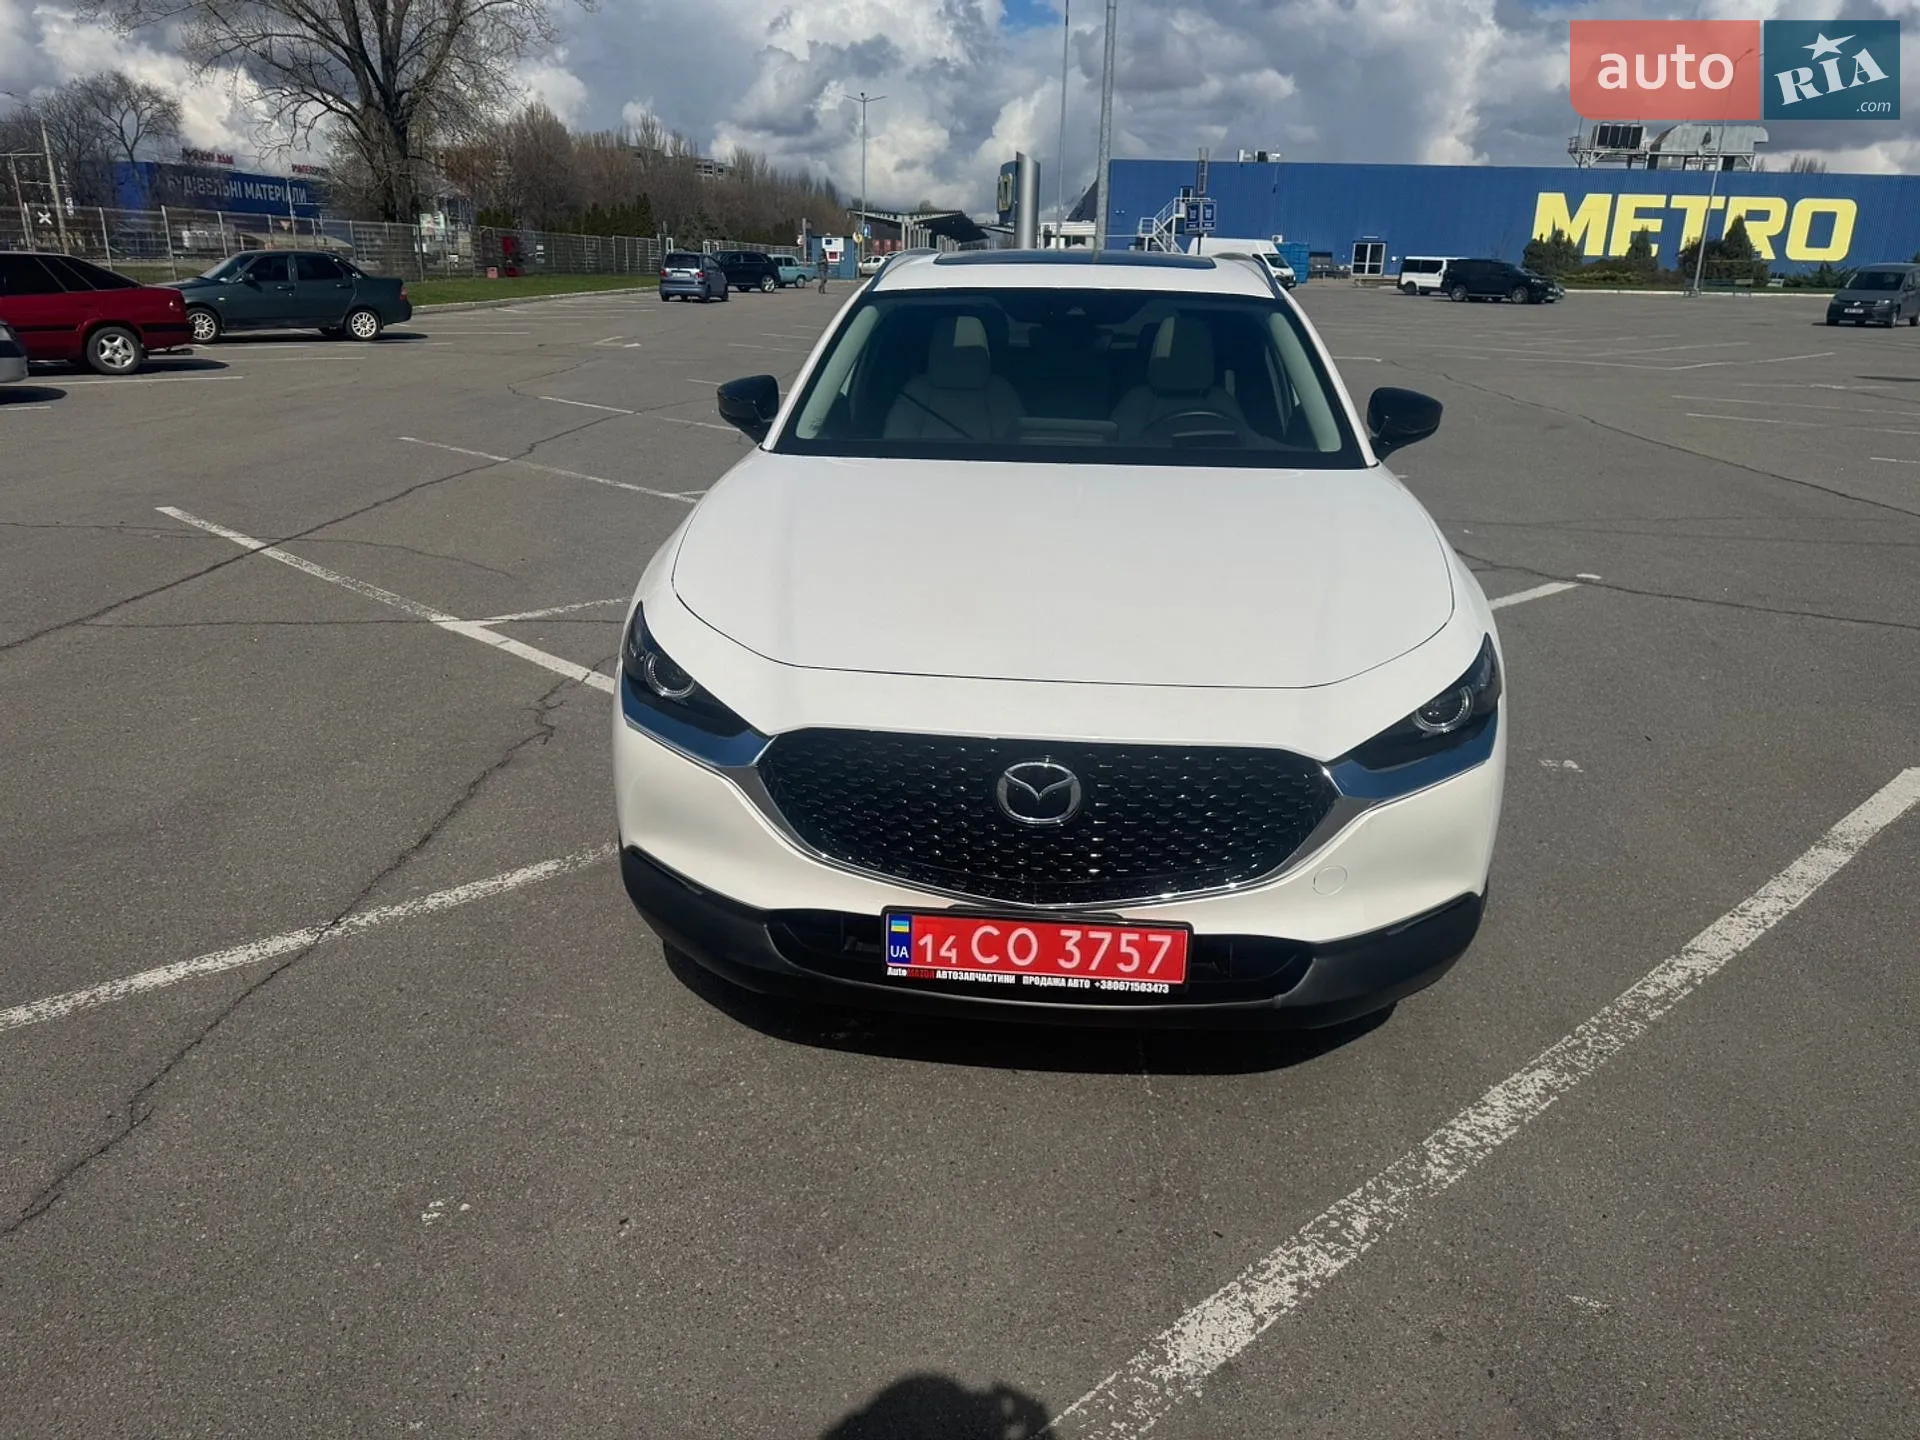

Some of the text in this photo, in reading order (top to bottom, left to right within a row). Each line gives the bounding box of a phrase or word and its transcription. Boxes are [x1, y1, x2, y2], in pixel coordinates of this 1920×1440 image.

[244, 182, 307, 204] МАТЕРІАЛИ
[1532, 192, 1858, 262] METRO
[890, 945, 910, 959] UA
[918, 925, 1174, 975] 14 CO 3757
[935, 970, 1016, 984] АВТОЗАПЧАСТИНИ
[1022, 975, 1067, 987] ПРОДАЖА
[1067, 978, 1091, 989] АВТО
